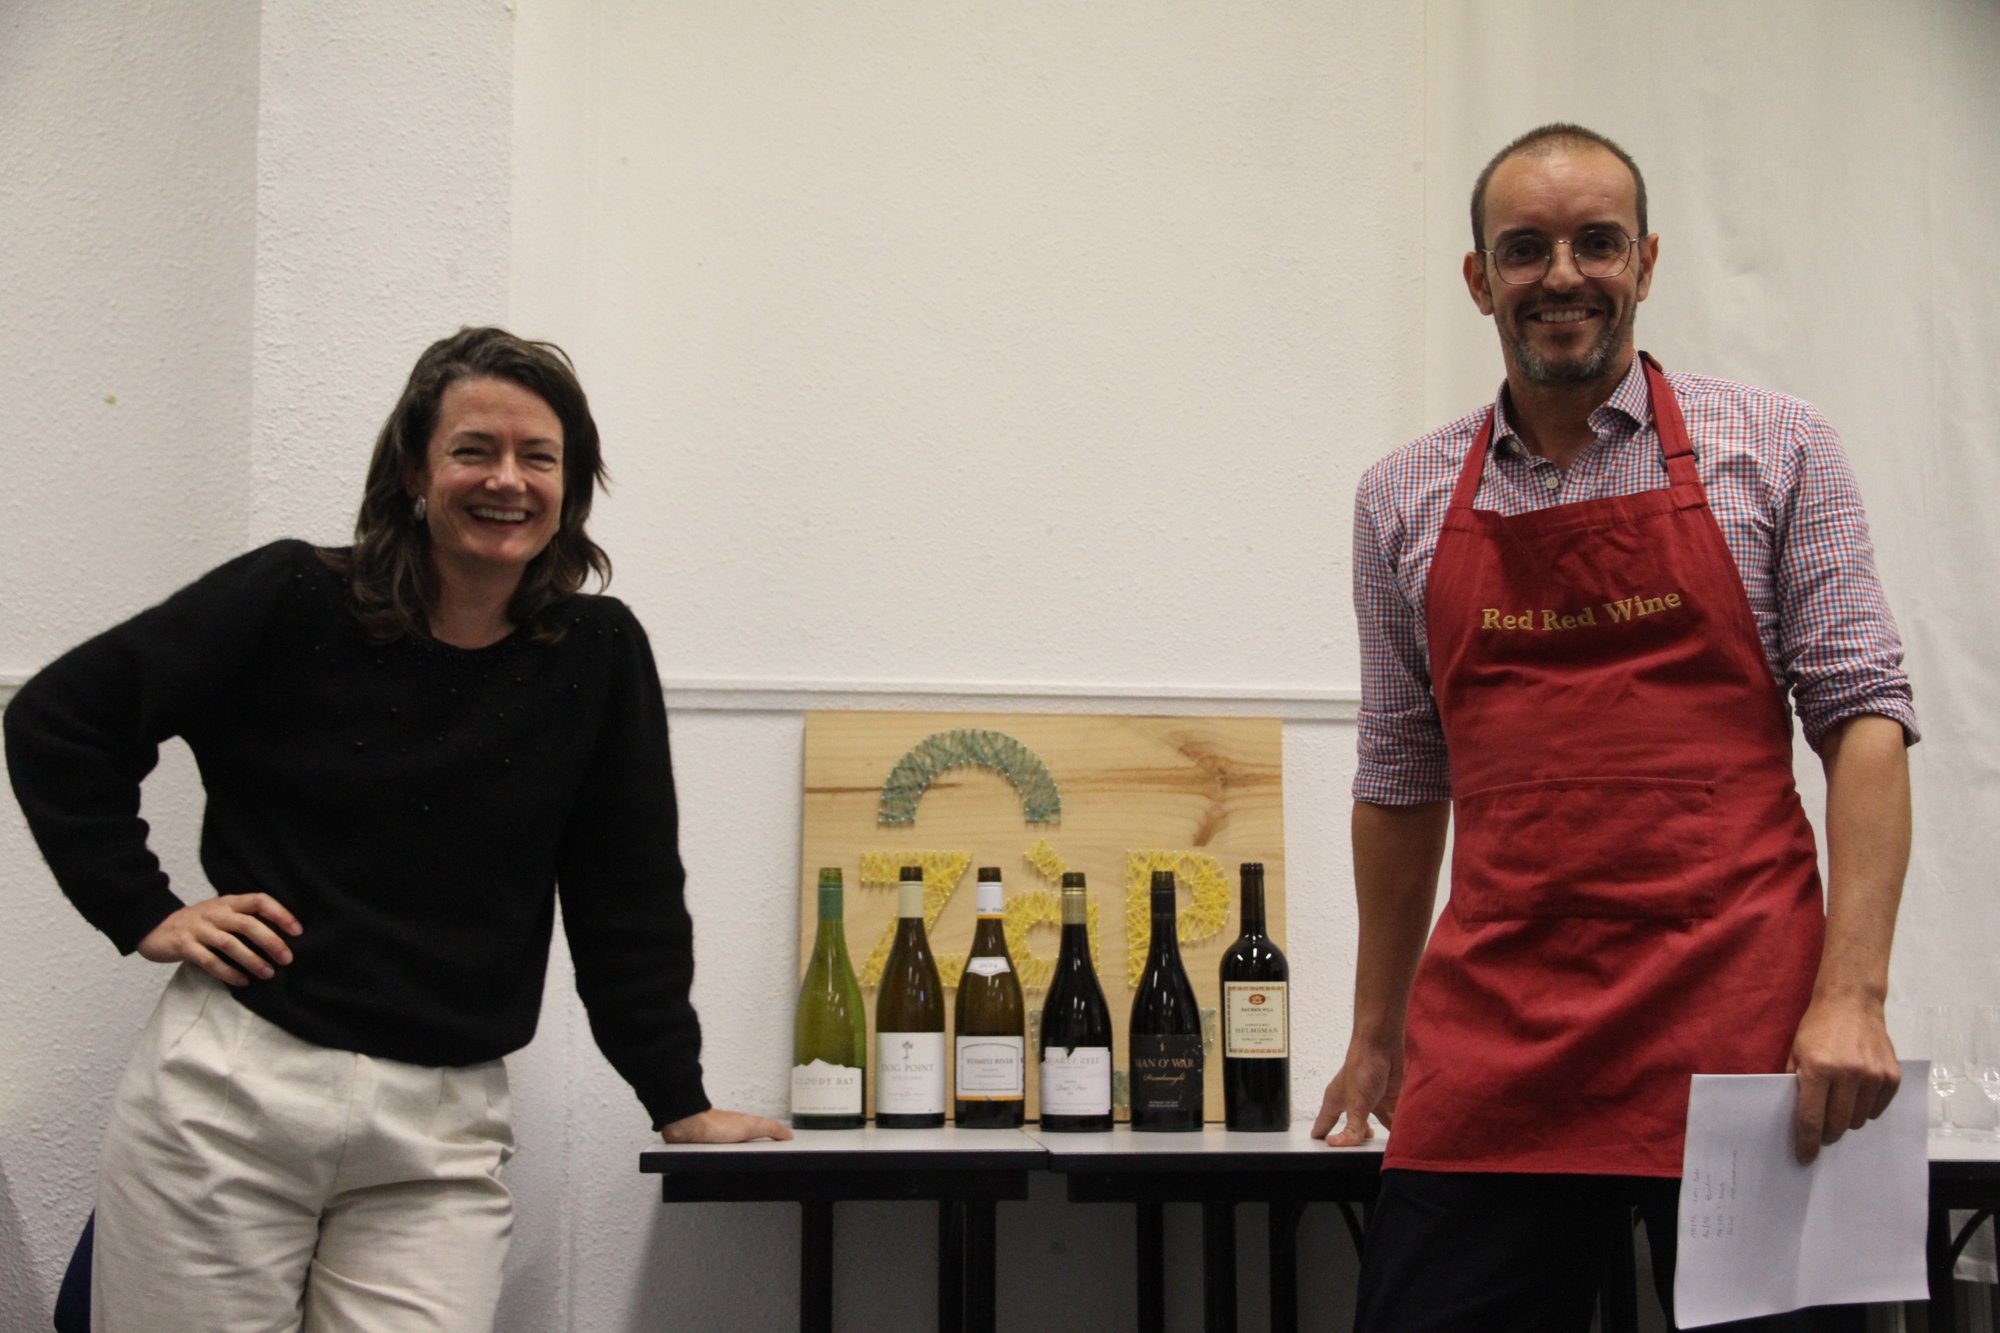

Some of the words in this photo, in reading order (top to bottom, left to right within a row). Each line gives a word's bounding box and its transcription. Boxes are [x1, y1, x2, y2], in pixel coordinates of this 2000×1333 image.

[1481, 607, 1534, 630] Red
[1541, 607, 1597, 631] Red
[1603, 592, 1682, 623] Wine
[881, 1063, 901, 1073] DOG
[904, 1063, 935, 1073] POINT
[1171, 1058, 1195, 1069] WAR
[836, 1077, 854, 1086] BAY
